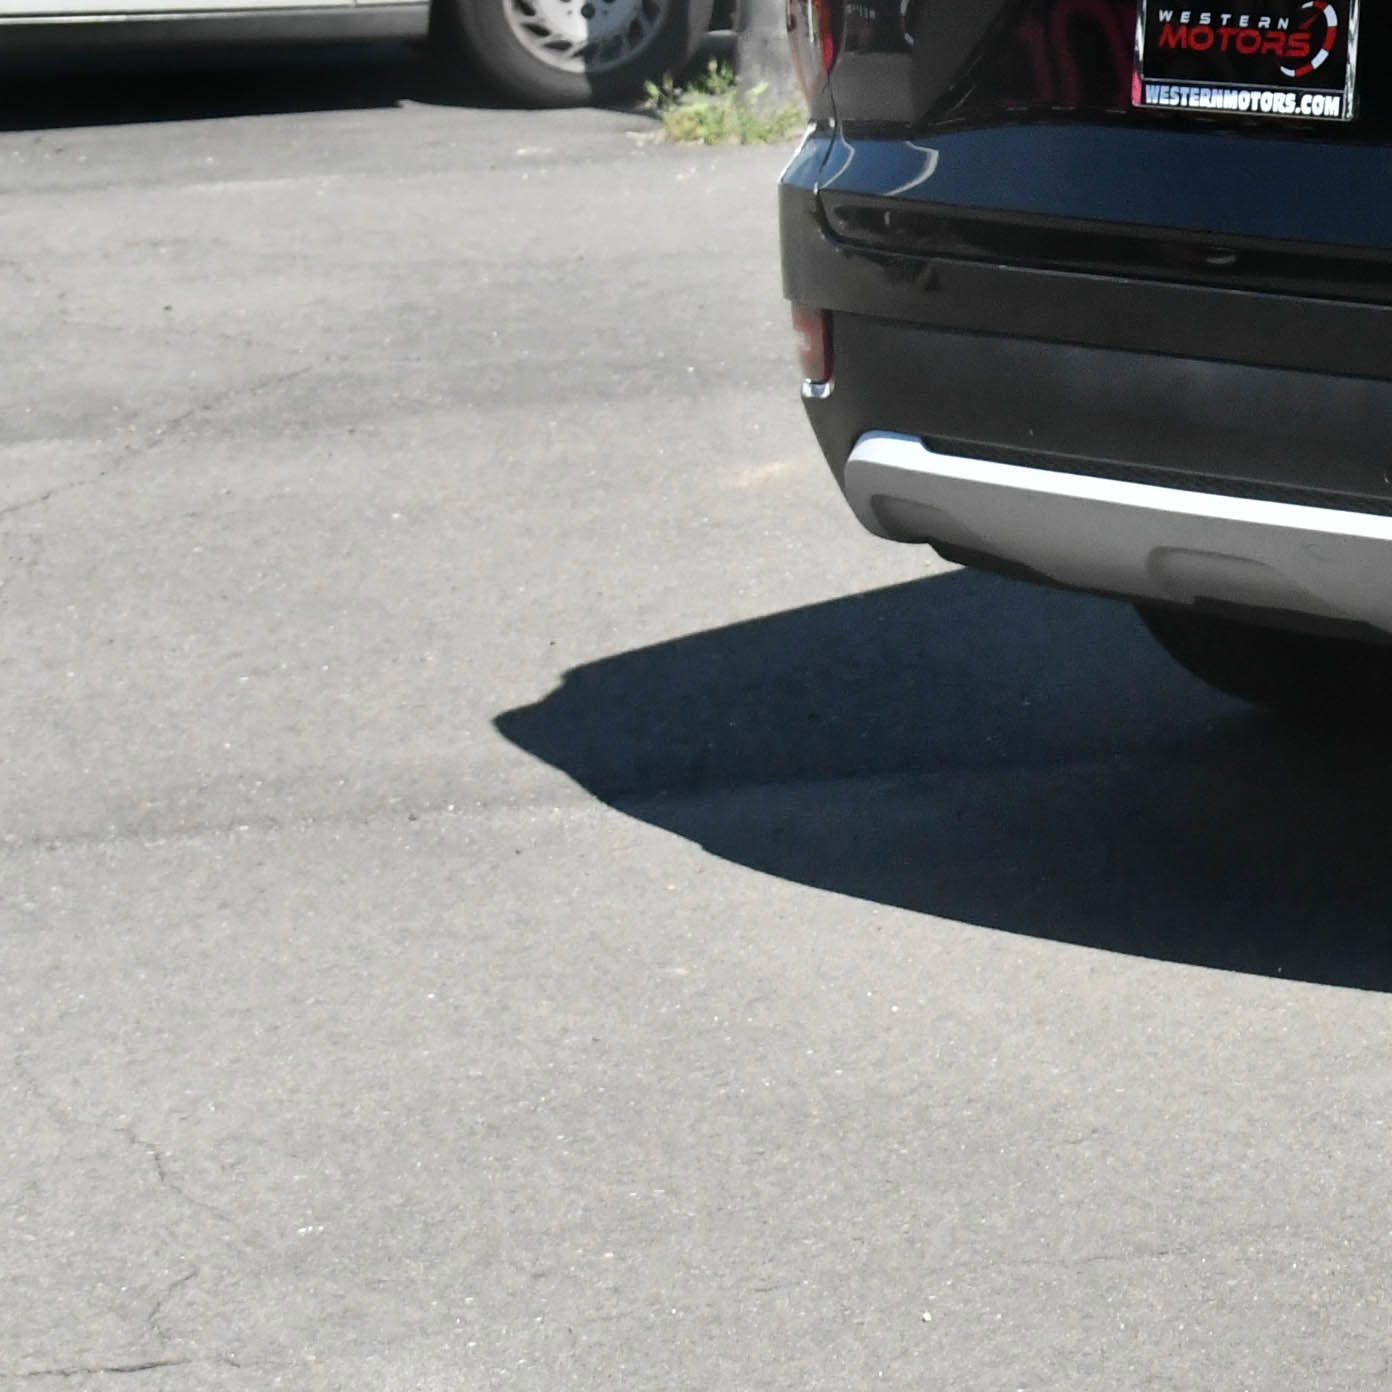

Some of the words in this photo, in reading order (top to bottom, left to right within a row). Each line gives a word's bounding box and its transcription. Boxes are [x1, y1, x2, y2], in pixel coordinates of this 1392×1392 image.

[1158, 9, 1290, 30] WESTERN
[1158, 23, 1313, 57] MOTORS
[1145, 84, 1341, 117] WESTERNMOTORS.COM
